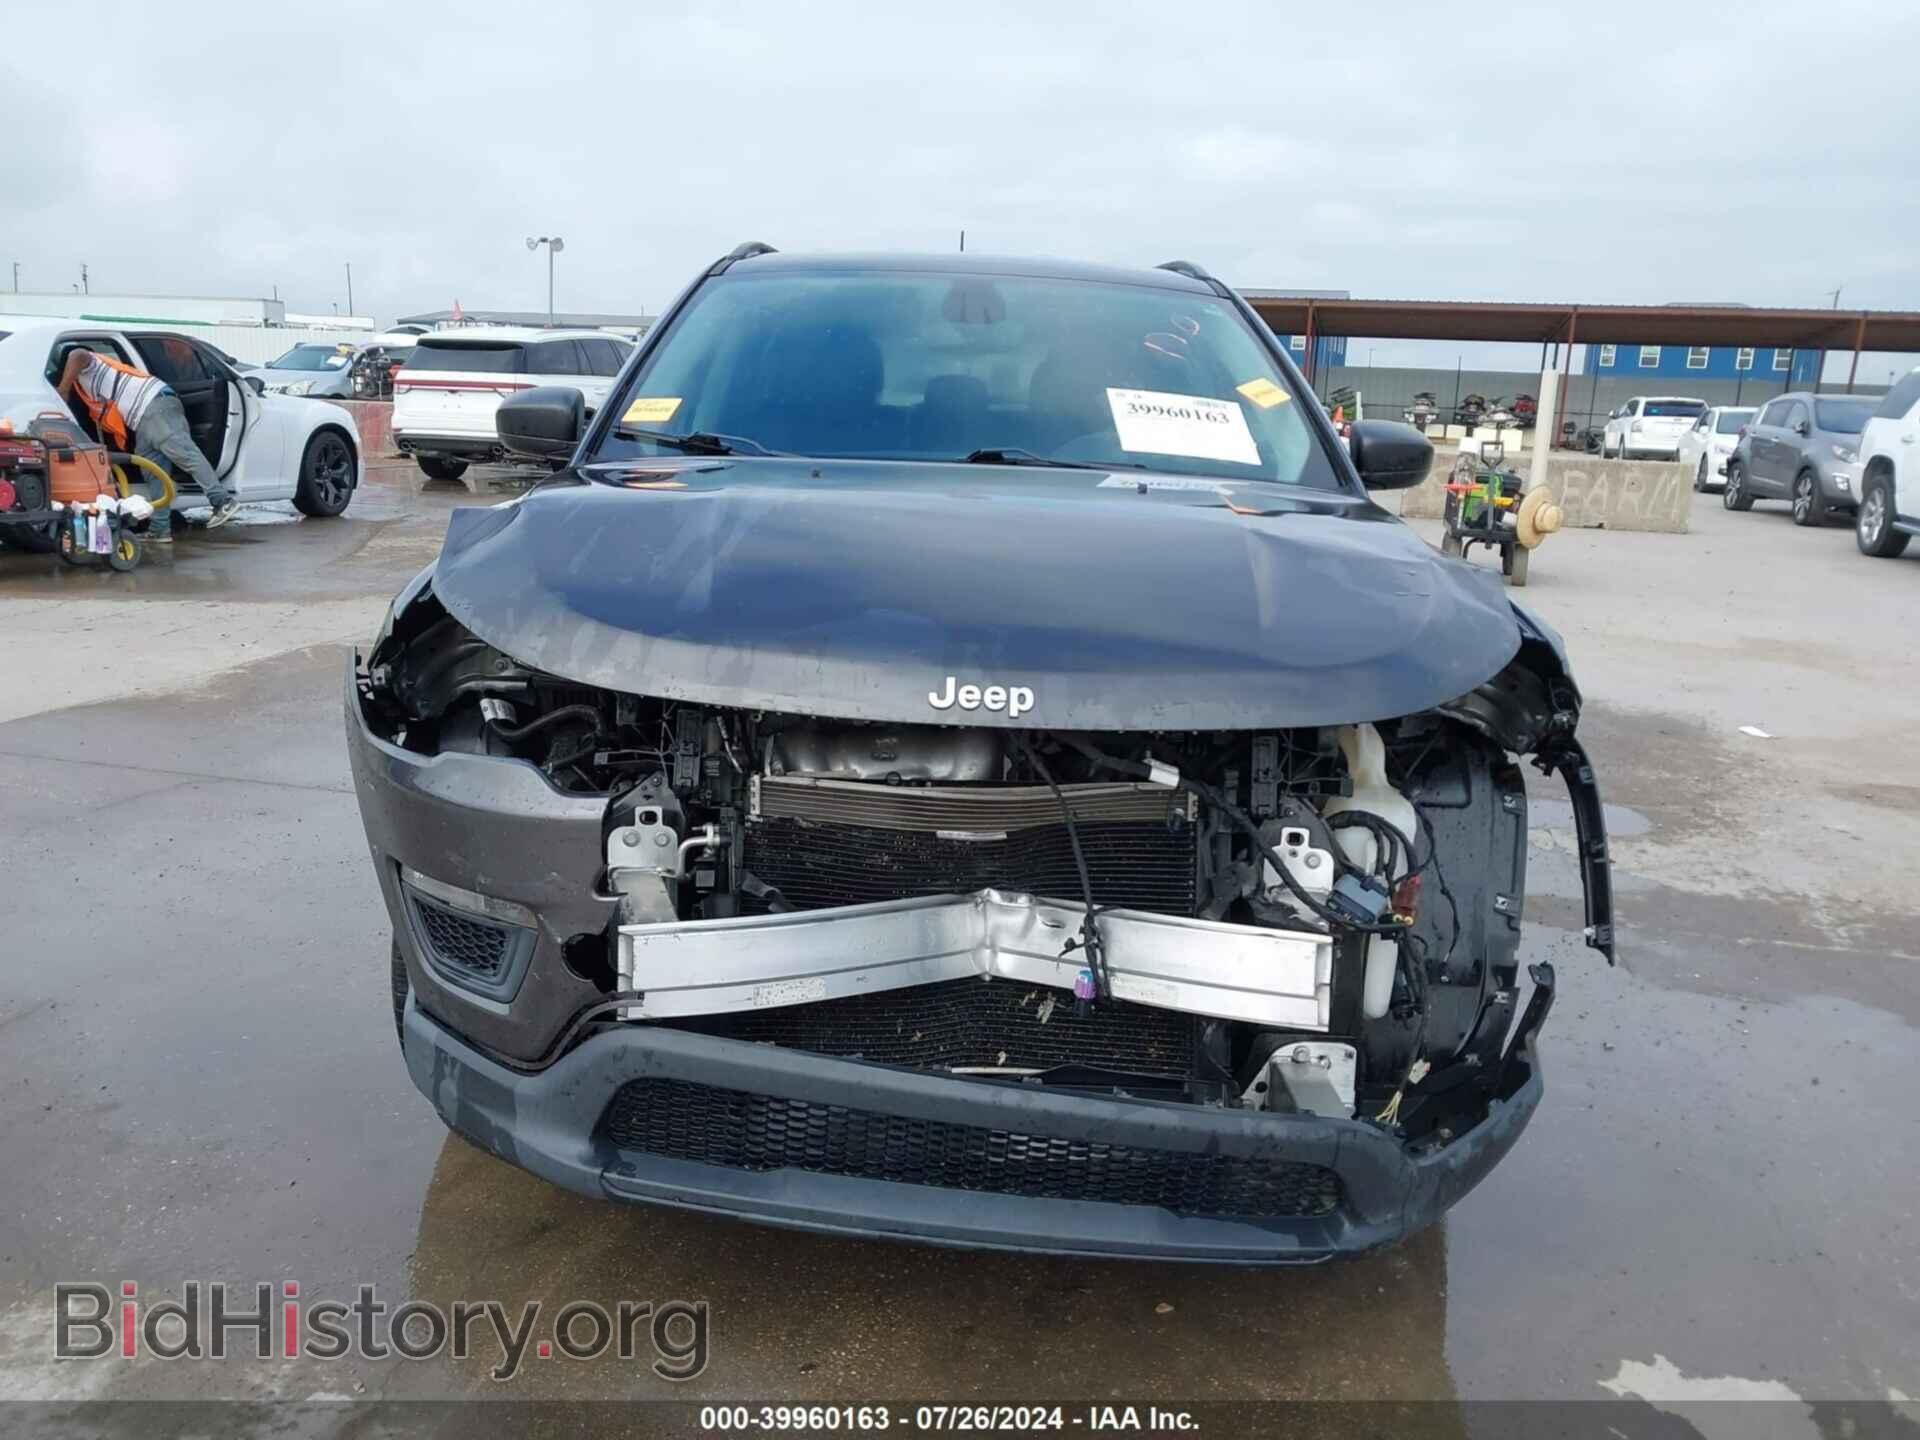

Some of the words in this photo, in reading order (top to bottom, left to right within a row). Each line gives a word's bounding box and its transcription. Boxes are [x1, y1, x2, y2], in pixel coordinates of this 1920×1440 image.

[1127, 402, 1230, 424] 39960163
[1560, 469, 1681, 521] FARM
[928, 676, 1035, 718] Jeep
